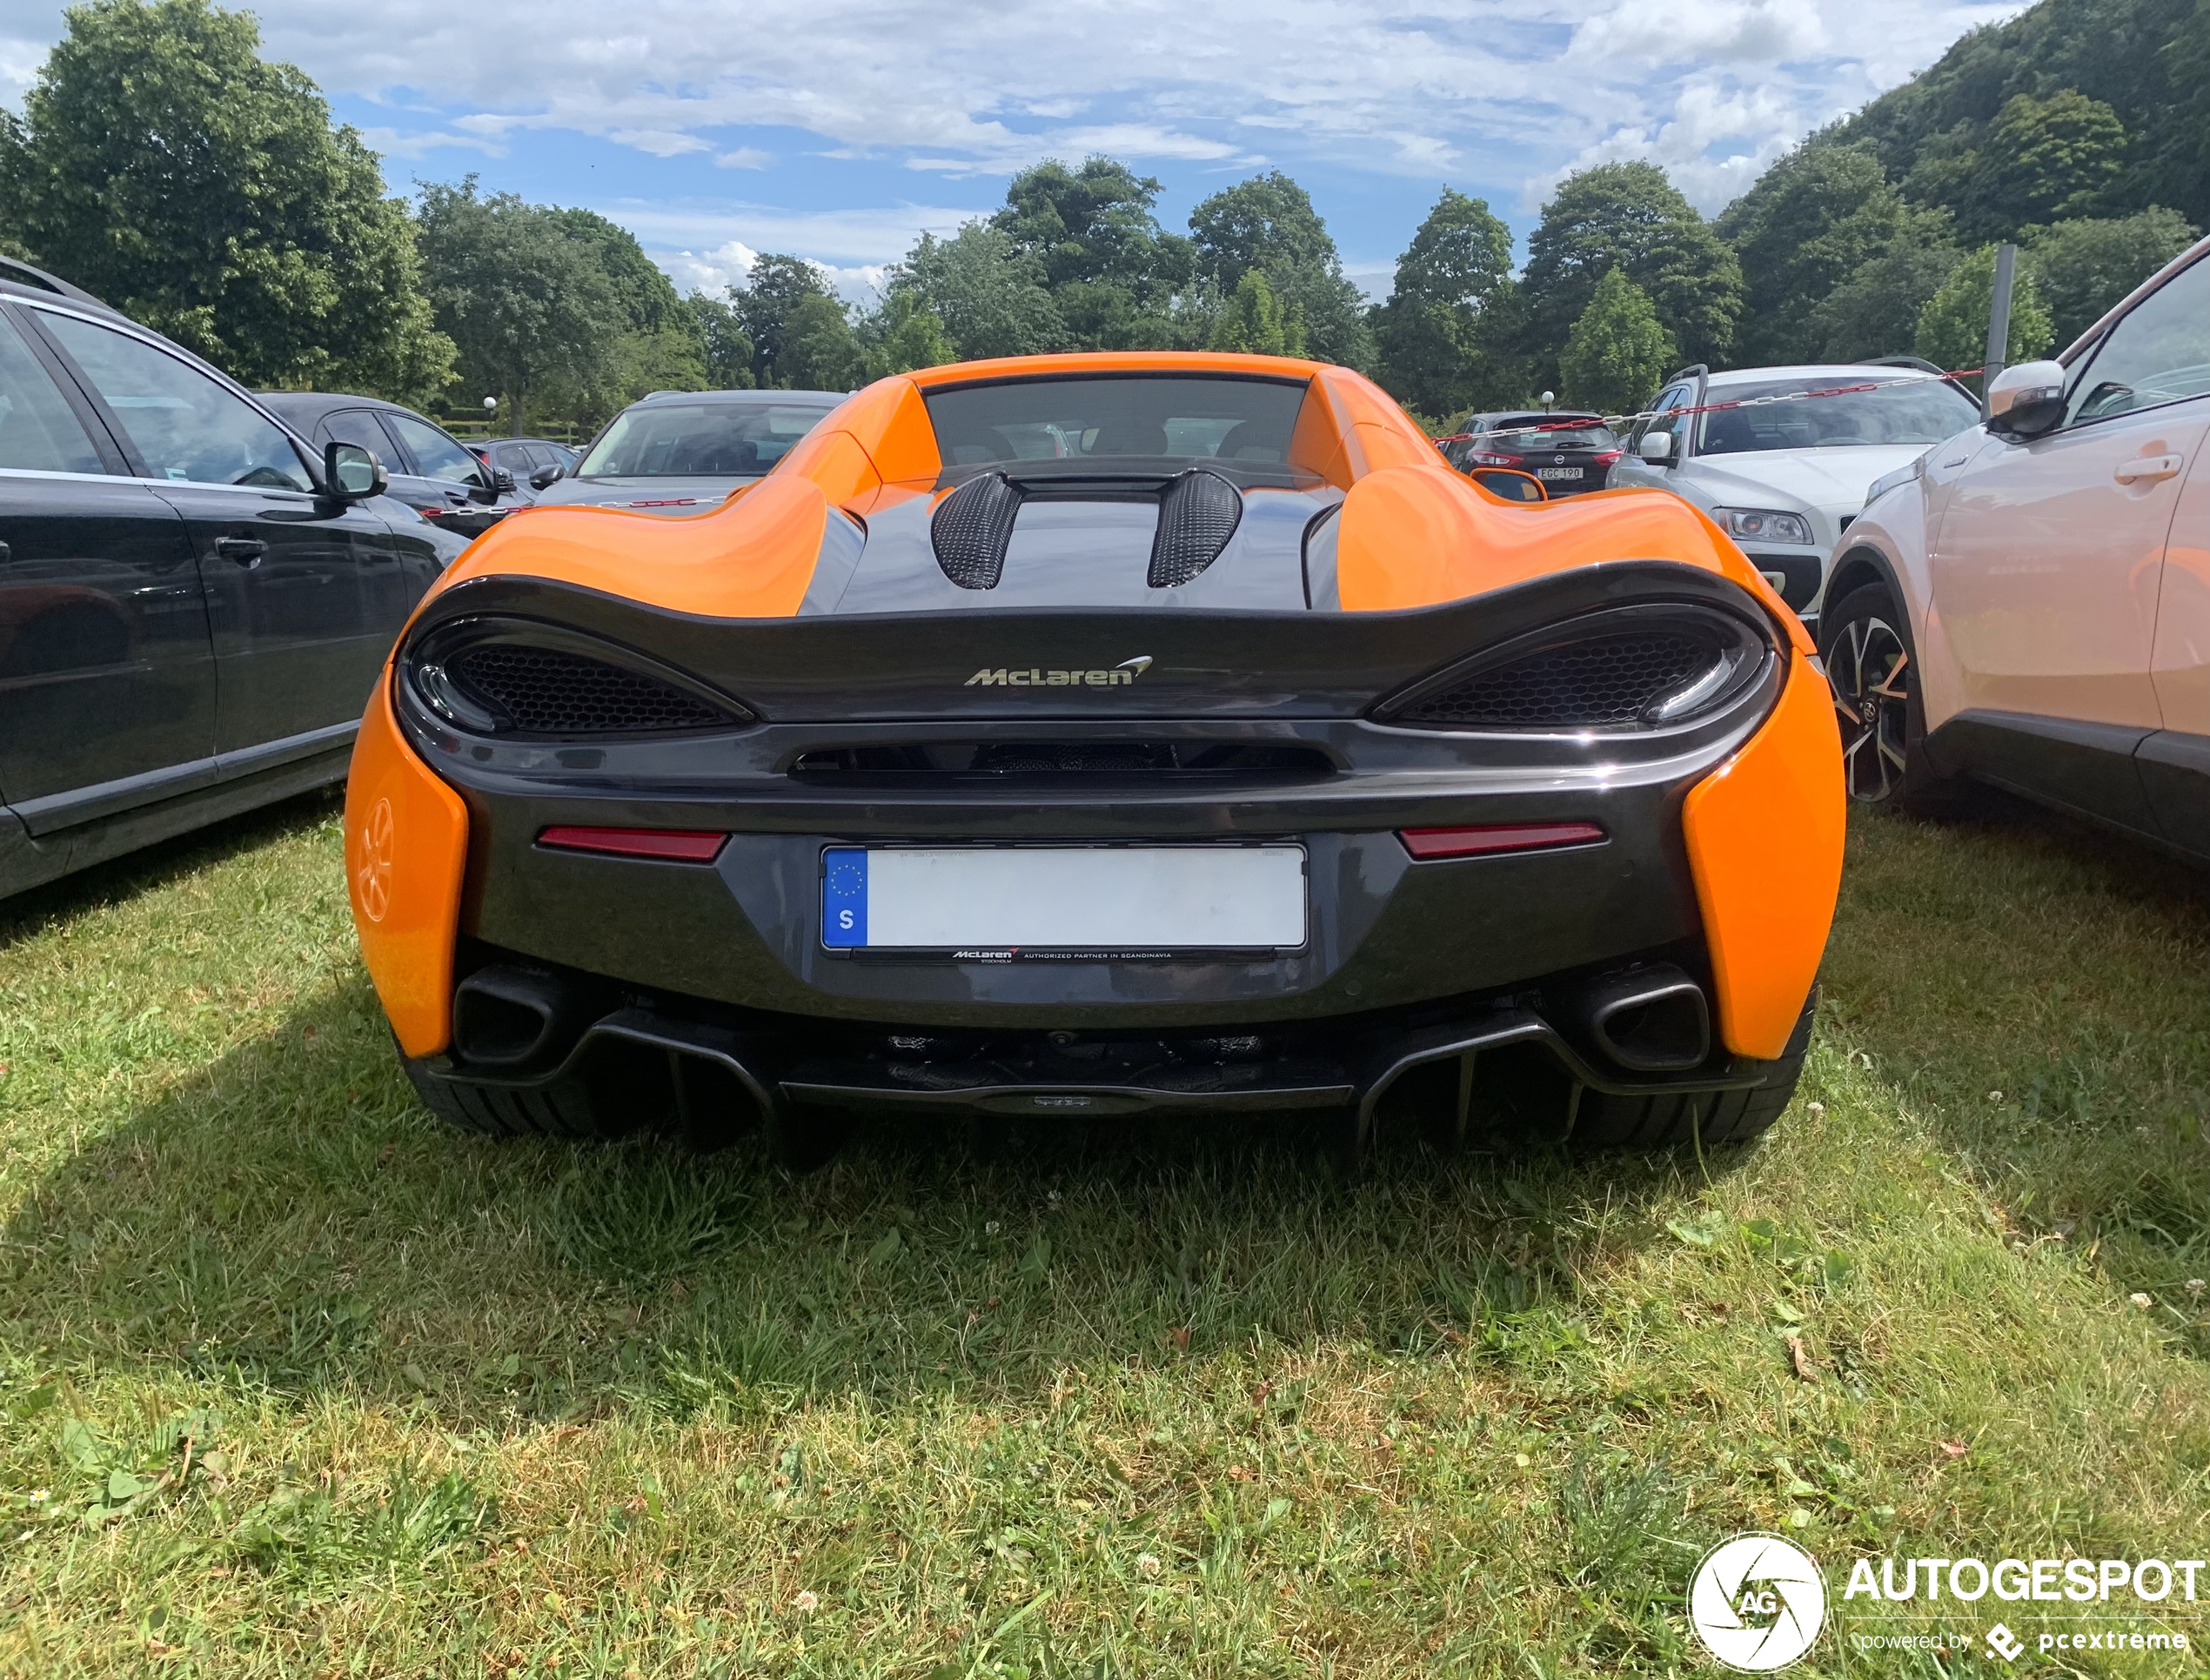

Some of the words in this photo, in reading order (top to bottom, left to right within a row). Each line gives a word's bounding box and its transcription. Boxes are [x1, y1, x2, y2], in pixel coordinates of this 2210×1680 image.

[1541, 468, 1559, 478] EGC
[1563, 468, 1580, 478] 190
[963, 667, 1134, 686] McLaren
[839, 909, 854, 930] S
[952, 950, 1013, 959] McLaren
